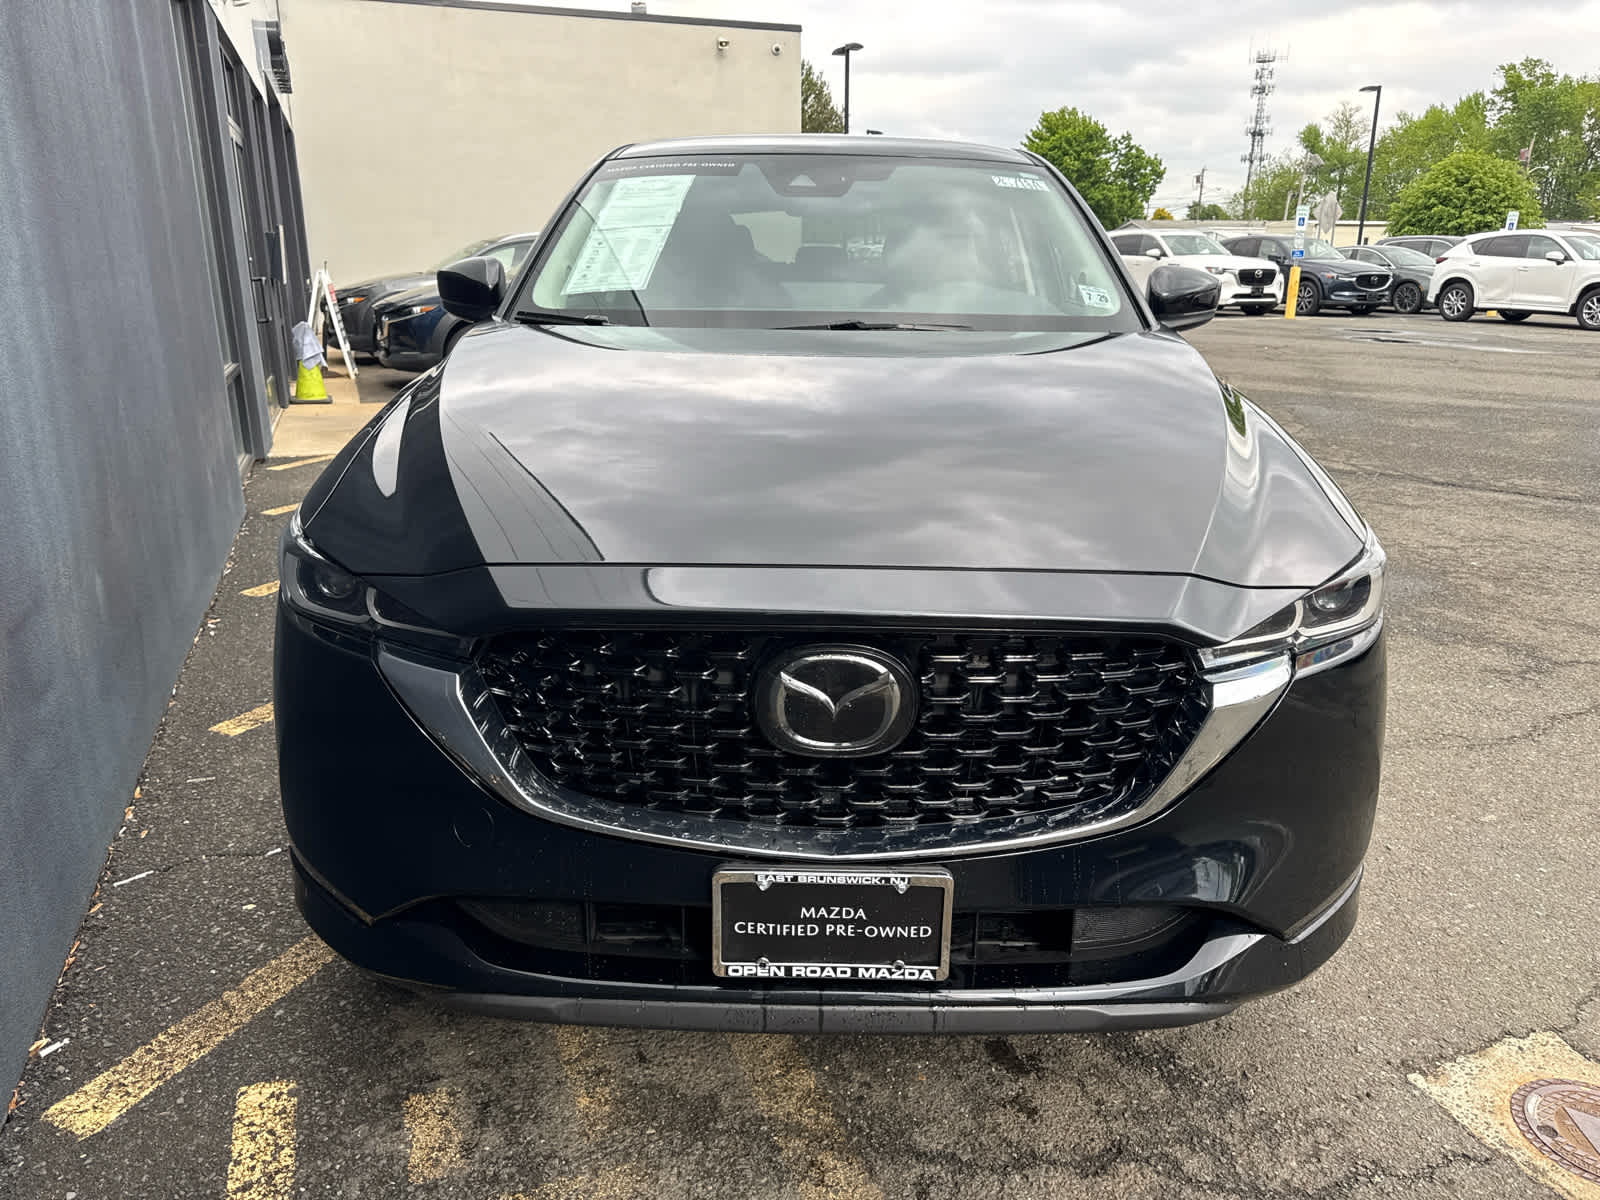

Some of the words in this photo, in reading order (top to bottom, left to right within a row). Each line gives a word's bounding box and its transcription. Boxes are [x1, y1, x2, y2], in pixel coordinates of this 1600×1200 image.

[757, 874, 793, 883] EAST
[890, 877, 909, 886] NJ
[800, 906, 867, 920] MAZDA
[734, 921, 819, 936] CERTIFIED
[826, 924, 932, 938] PRE-OWNED
[727, 965, 785, 977] OPEN
[792, 966, 851, 978] ROAD
[858, 967, 935, 980] MAZDA
